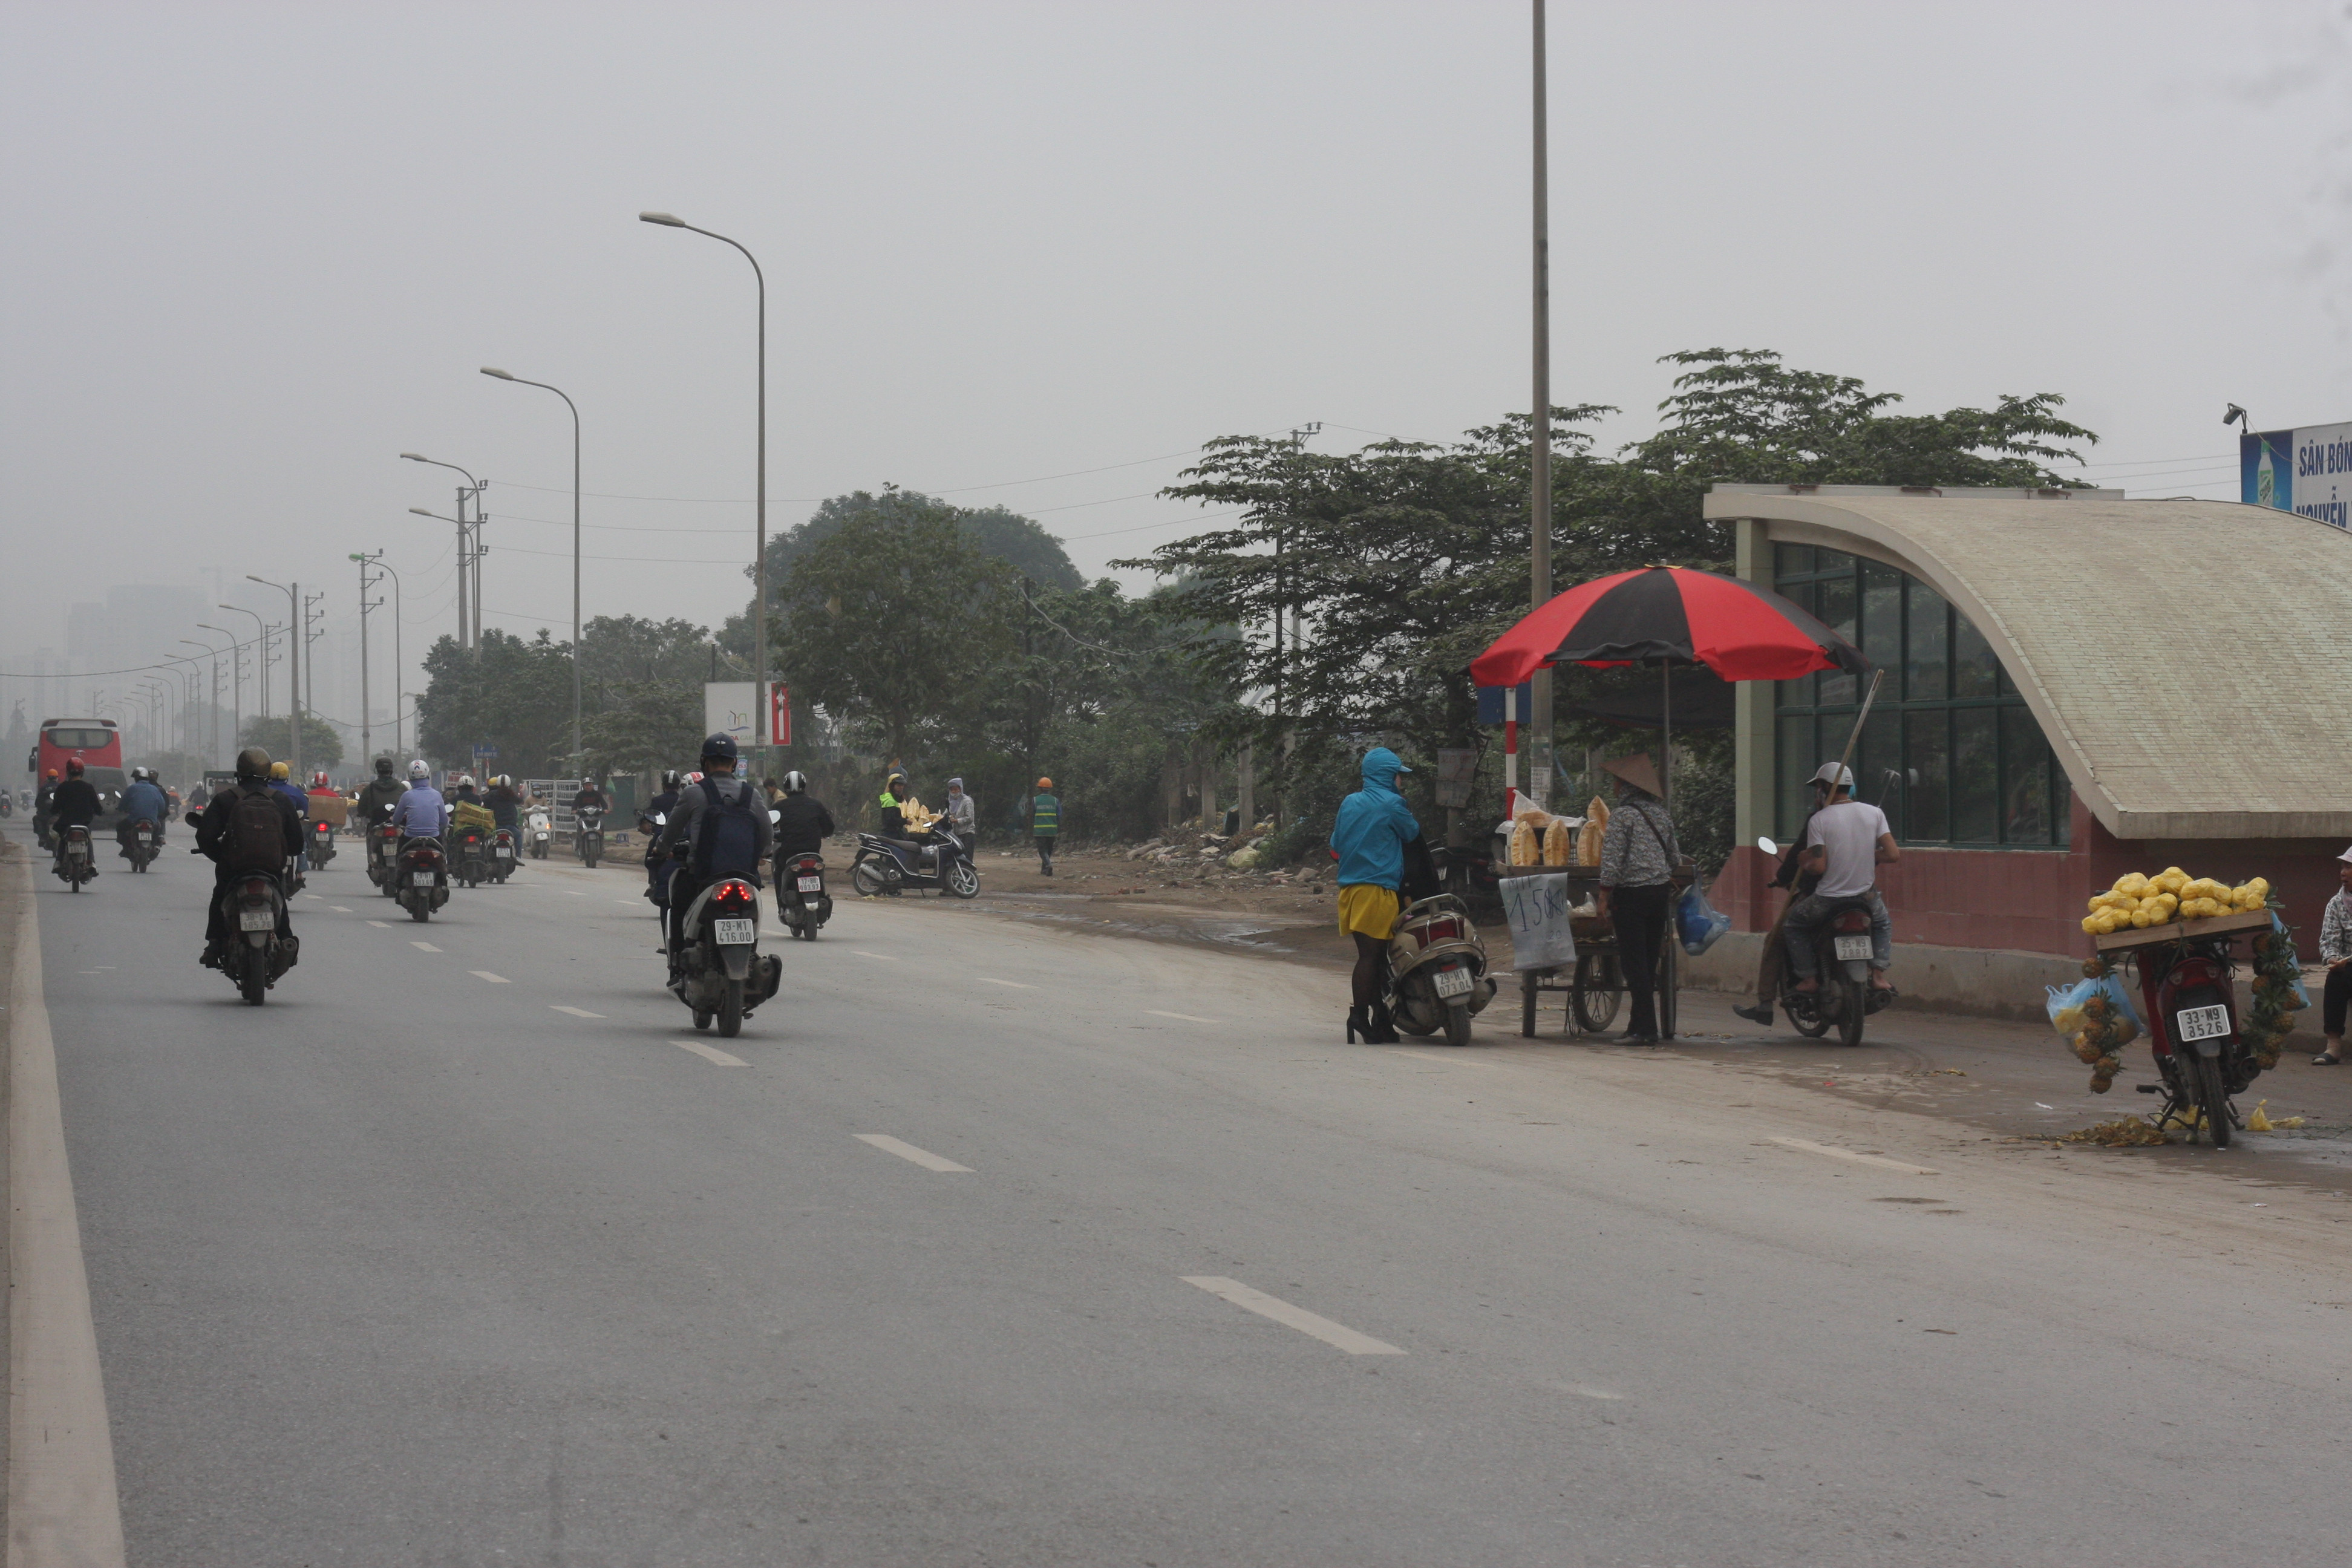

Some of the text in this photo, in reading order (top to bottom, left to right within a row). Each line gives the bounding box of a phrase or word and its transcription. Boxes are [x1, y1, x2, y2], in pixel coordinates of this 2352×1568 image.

[2299, 439, 2324, 477] SÂN
[721, 921, 747, 932] 29-M1
[719, 932, 751, 942] 416.00
[1439, 969, 1465, 985] 29-H1
[1440, 978, 1471, 996] 073.04
[2185, 1008, 2220, 1024] 33-N9
